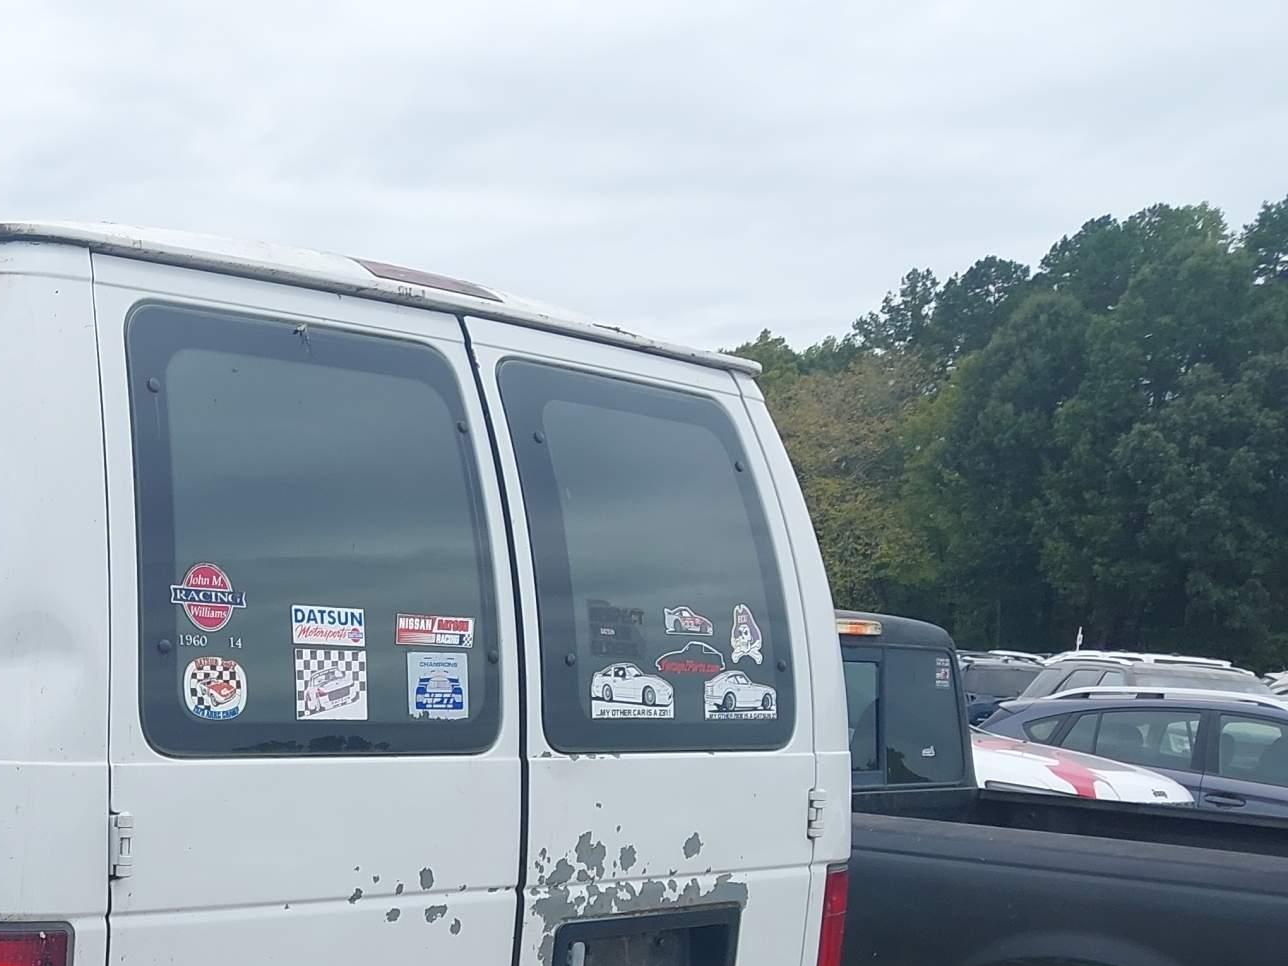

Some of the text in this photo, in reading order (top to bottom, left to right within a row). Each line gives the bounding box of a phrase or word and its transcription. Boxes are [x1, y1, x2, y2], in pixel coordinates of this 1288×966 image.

[188, 573, 224, 588] John M.
[175, 588, 241, 604] RACING
[190, 604, 228, 619] Williams
[293, 607, 363, 627] DATSUN
[399, 617, 433, 631] NISSAN
[295, 624, 349, 641] Motorsports
[436, 633, 460, 645] RACING
[178, 634, 208, 647] 1960
[229, 636, 242, 648] 14
[611, 708, 632, 717] OTHER
[633, 708, 646, 717] CAR
[646, 708, 653, 717] IS
